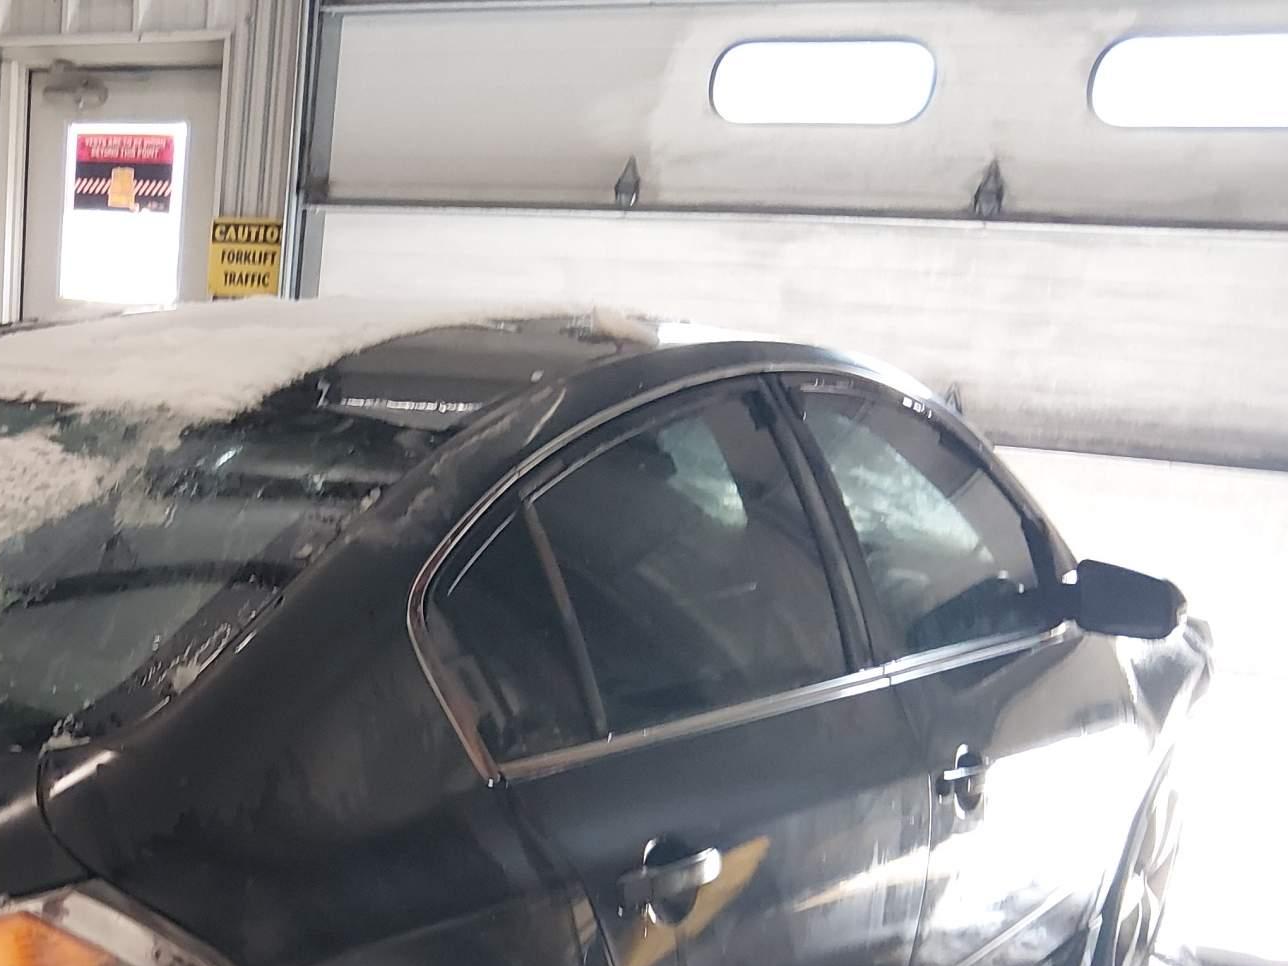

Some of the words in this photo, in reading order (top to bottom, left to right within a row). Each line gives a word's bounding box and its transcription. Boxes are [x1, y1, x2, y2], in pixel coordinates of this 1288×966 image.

[214, 224, 283, 244] CAUTIO
[220, 249, 277, 267] FORKLIFT
[223, 271, 271, 288] TRAFFIC
